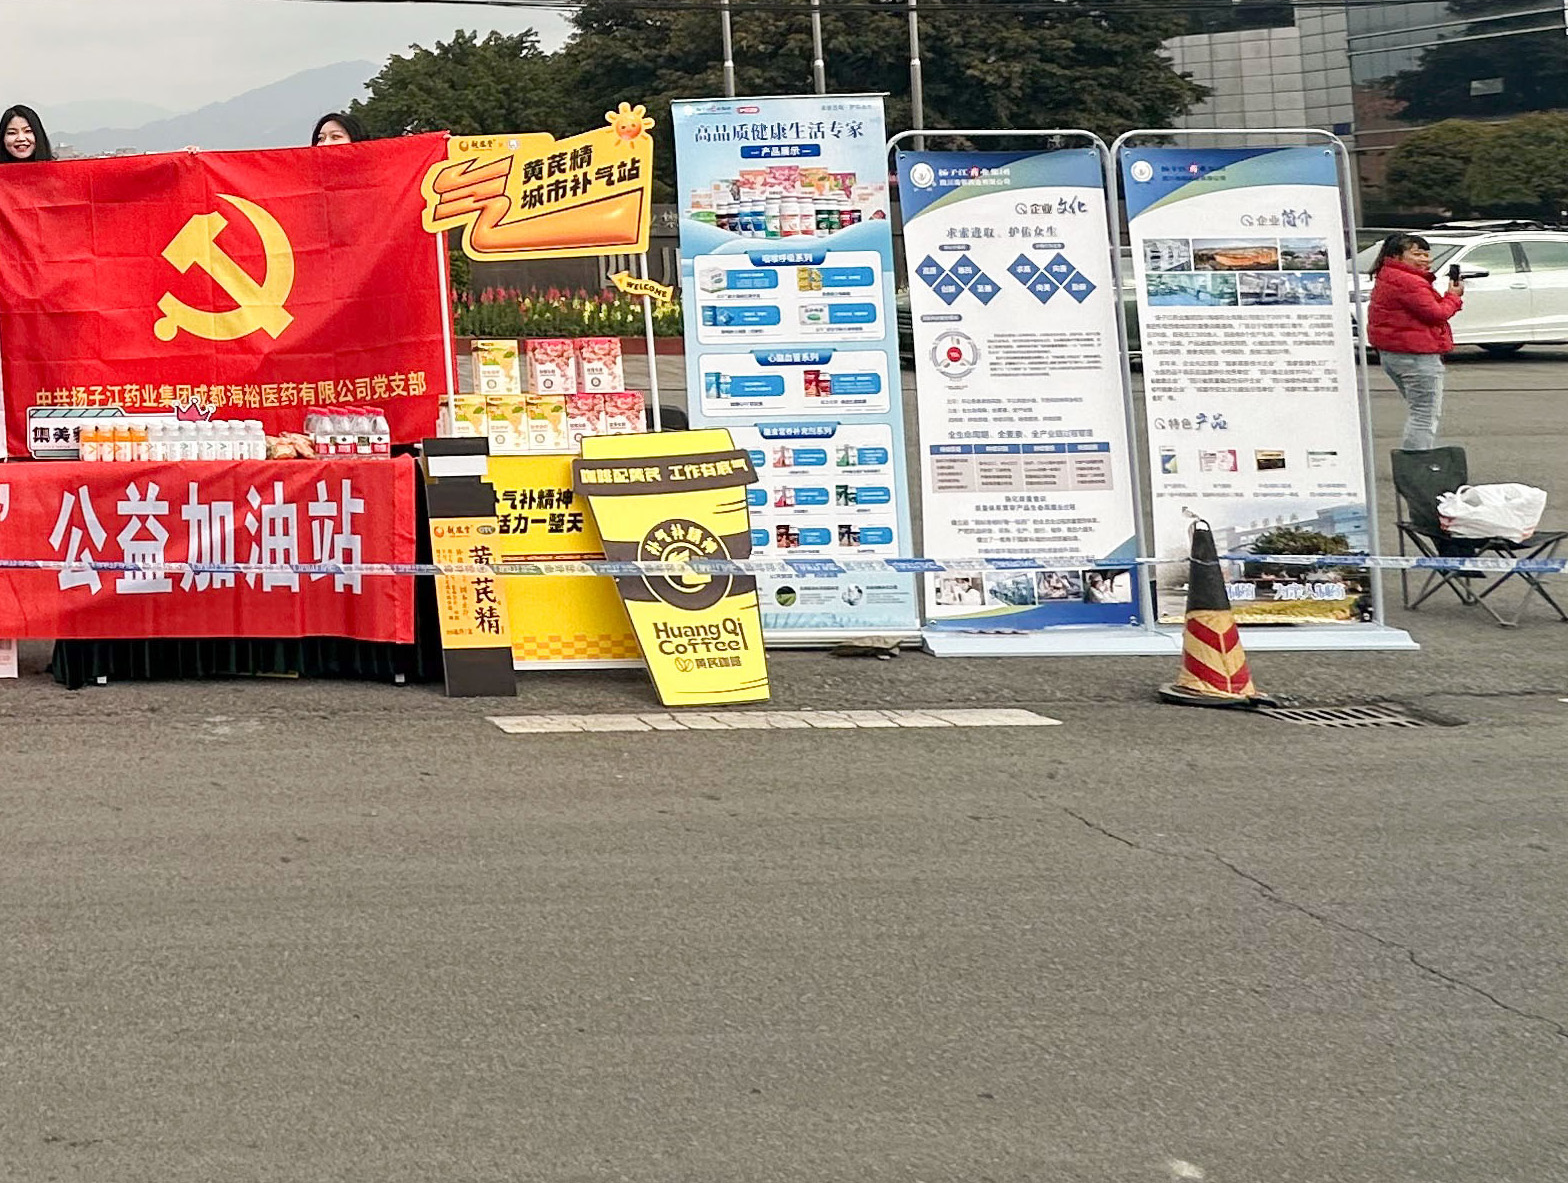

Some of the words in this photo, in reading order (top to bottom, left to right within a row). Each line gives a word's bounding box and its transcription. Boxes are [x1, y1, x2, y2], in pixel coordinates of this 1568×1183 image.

[695, 120, 864, 143] 高品质健康生活专家
[761, 146, 800, 157] 产品展示
[522, 145, 593, 185] 黄芪精
[520, 157, 641, 210] 城市补气站
[1256, 208, 1313, 229] 企业简介
[626, 281, 668, 298] WELCOME
[668, 458, 749, 481] 工作有底气
[497, 512, 584, 534] 活力一整天
[48, 479, 367, 596] 公益加油站
[468, 545, 500, 635] 黄芪精
[658, 637, 741, 655] Coffee
